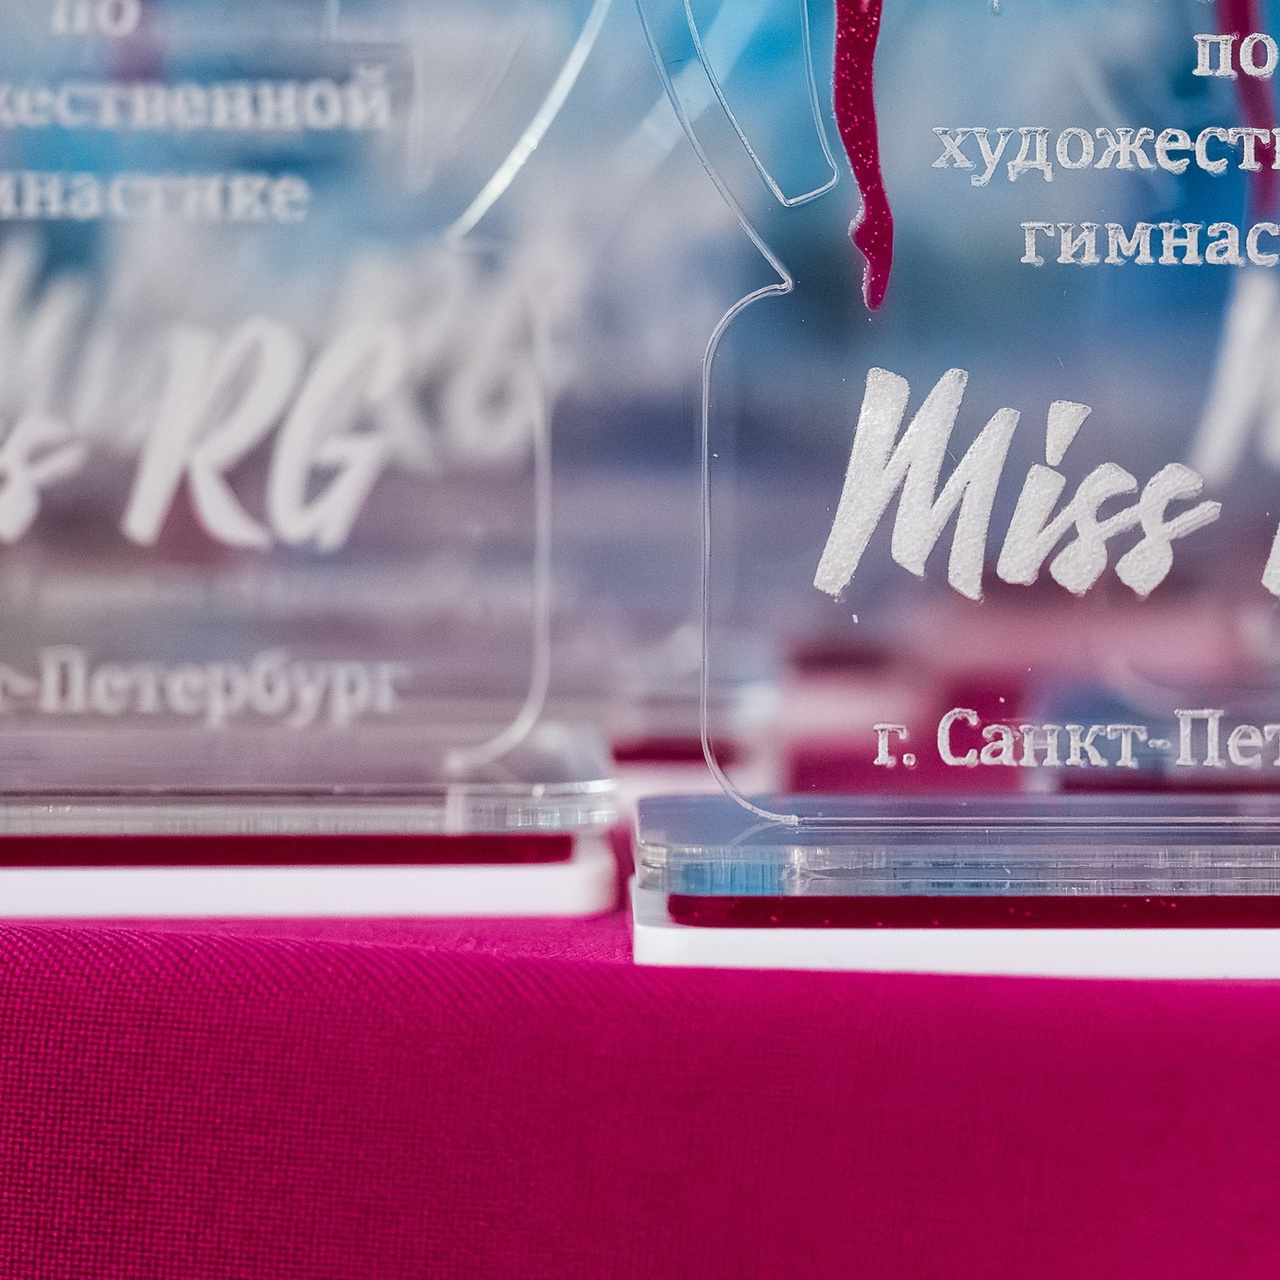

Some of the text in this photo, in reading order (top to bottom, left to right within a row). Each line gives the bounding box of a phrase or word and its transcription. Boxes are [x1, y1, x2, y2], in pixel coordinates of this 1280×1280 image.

[1192, 32, 1279, 80] по
[120, 317, 402, 552] RG
[813, 366, 1222, 602] Miss
[873, 719, 917, 767] г.
